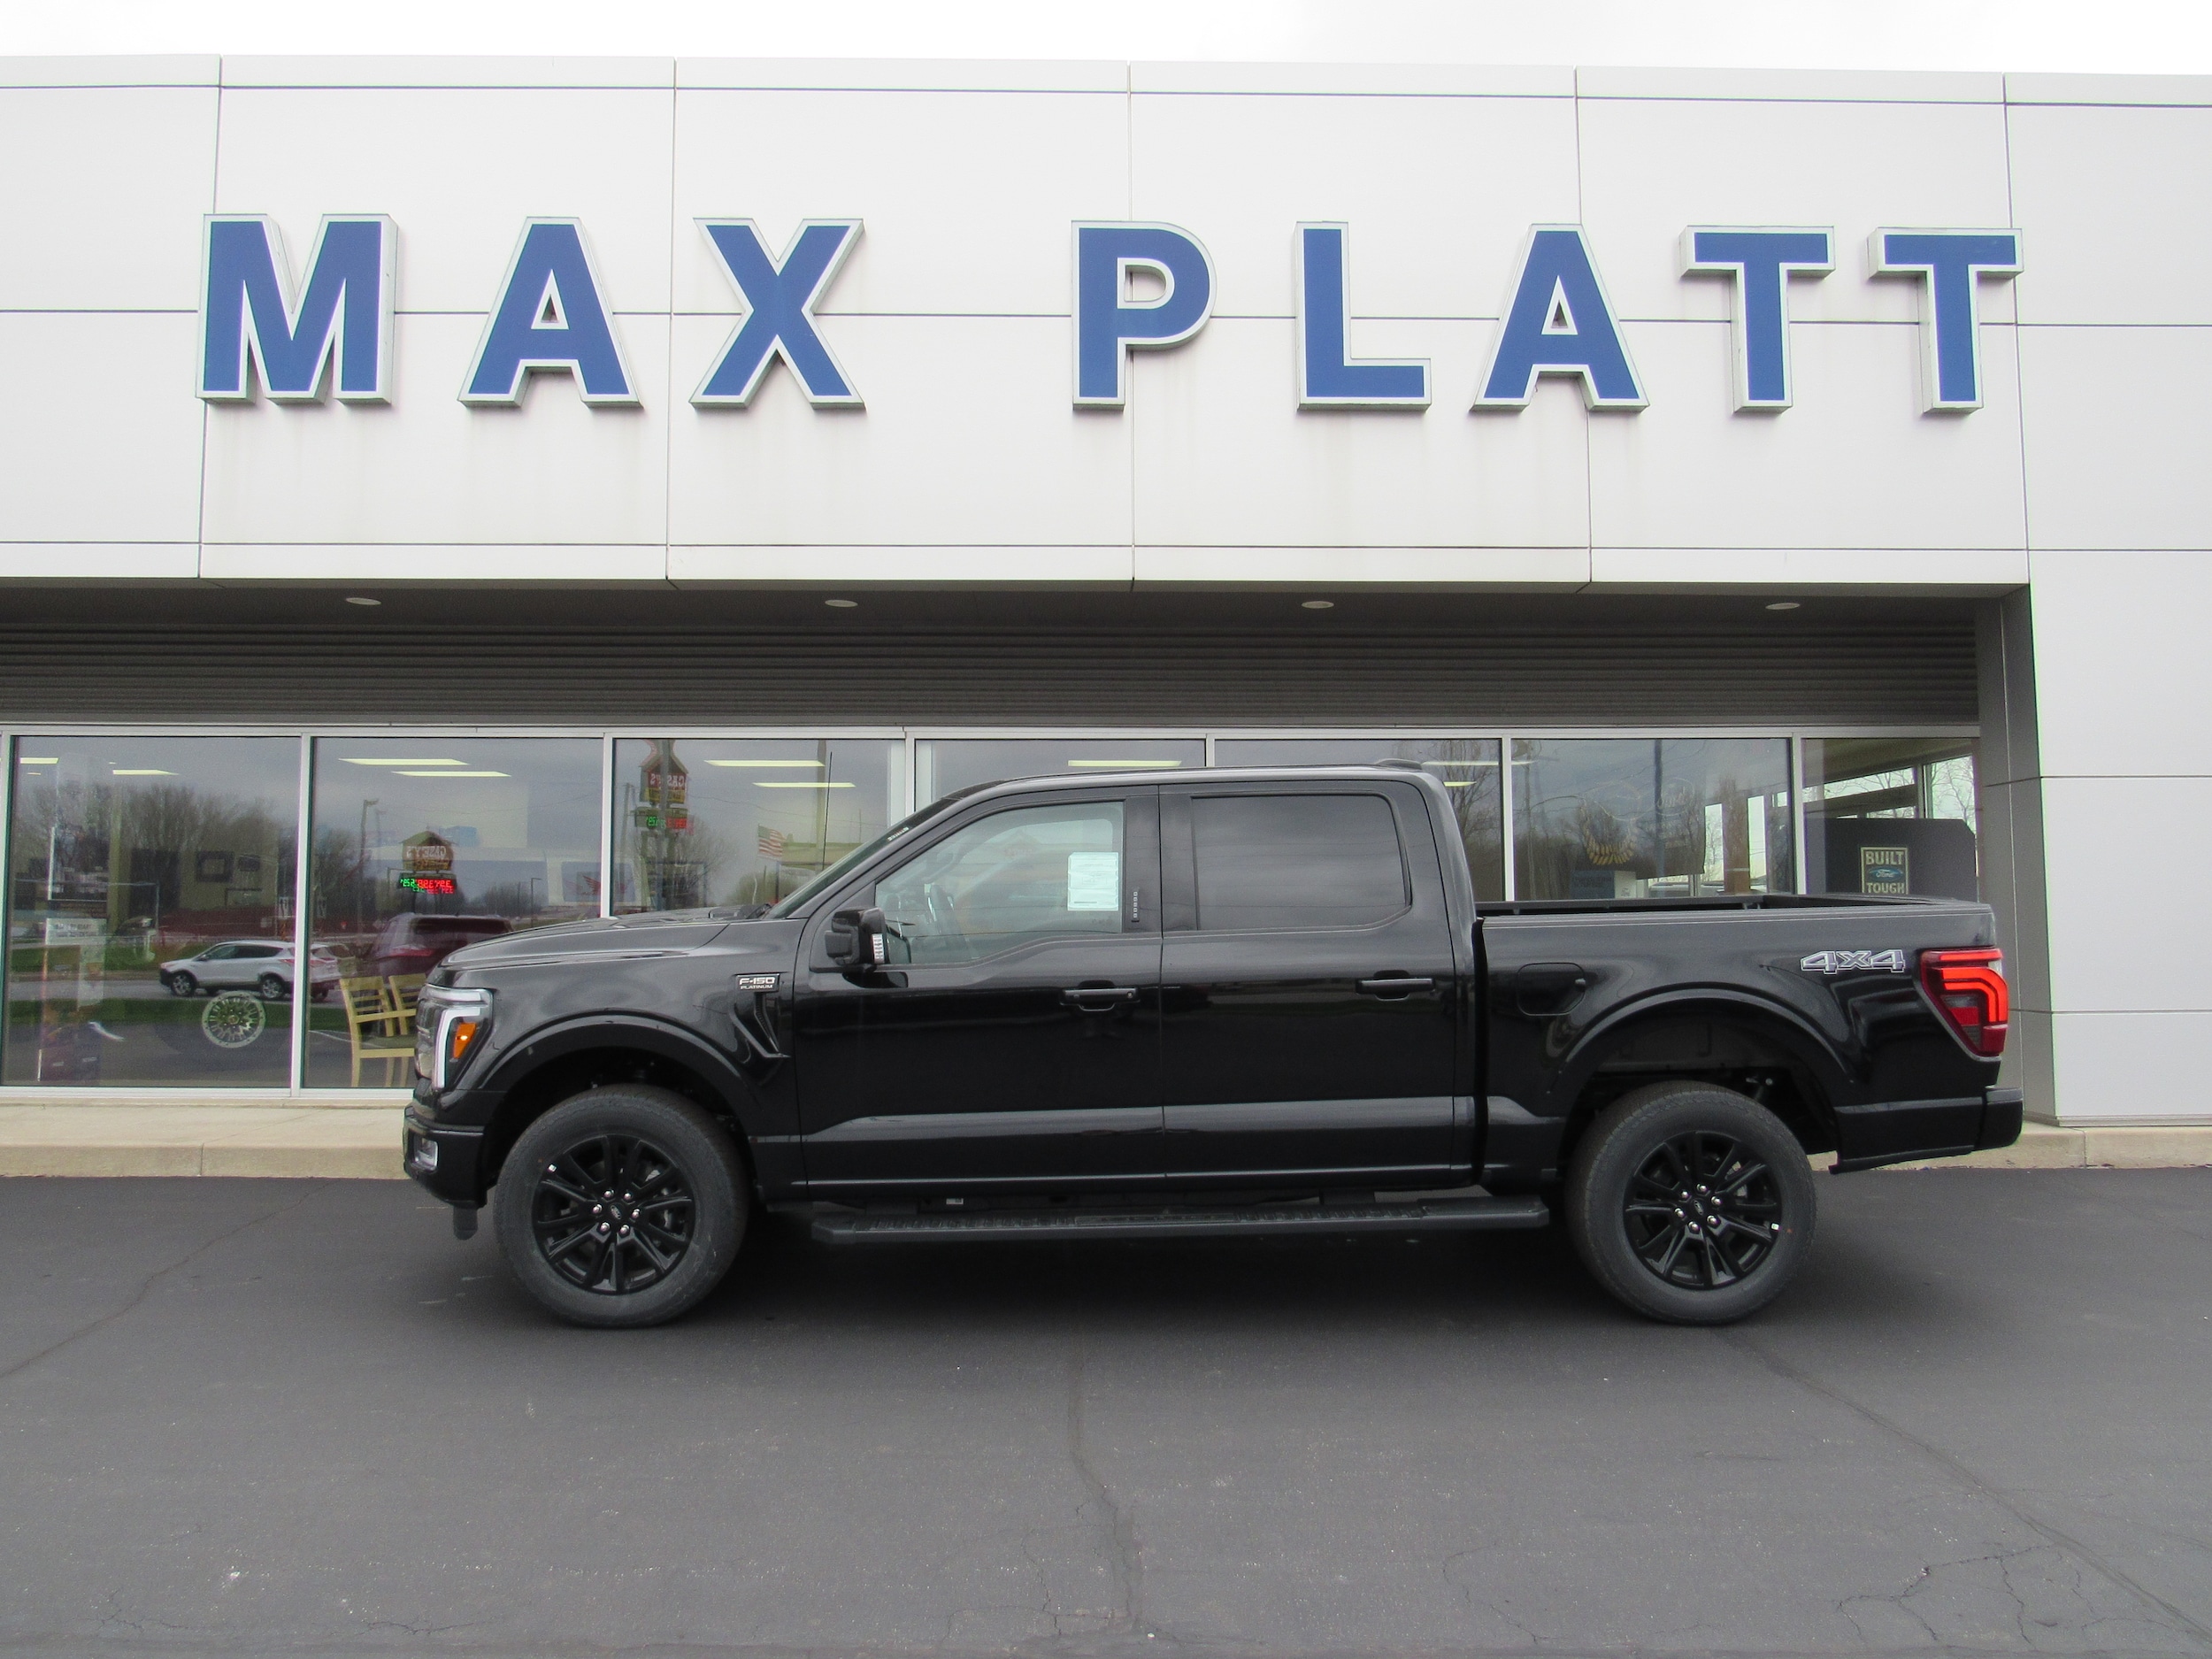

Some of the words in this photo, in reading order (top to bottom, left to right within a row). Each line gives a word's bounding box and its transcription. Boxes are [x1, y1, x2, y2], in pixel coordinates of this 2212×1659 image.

[198, 214, 867, 407] MAX
[1071, 220, 2024, 414] PLATT
[1865, 850, 1904, 864] BUILT
[1867, 883, 1905, 894] TOUGH
